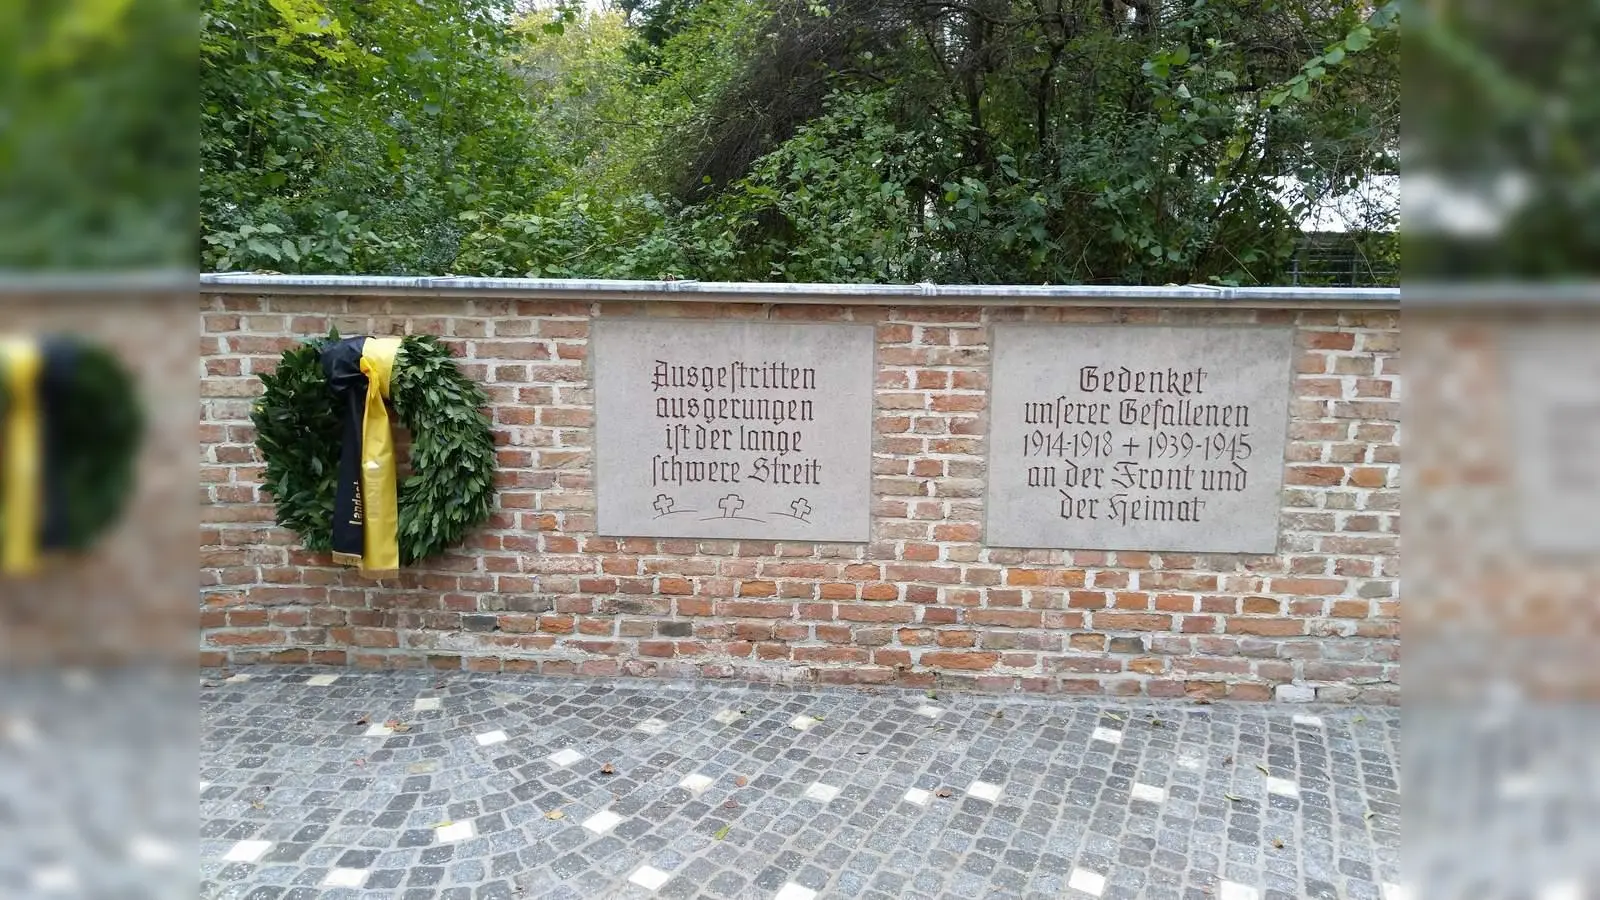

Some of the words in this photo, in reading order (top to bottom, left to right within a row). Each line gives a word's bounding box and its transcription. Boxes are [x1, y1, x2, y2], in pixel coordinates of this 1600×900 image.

[1080, 366, 1208, 396] Gedenket
[656, 397, 814, 425] ausgerungen
[1119, 398, 1249, 430] Gefallenen
[696, 424, 732, 450] der
[740, 425, 802, 456] lange
[1024, 430, 1112, 458] 1914-1918
[1148, 432, 1252, 461] 1939-1945
[747, 456, 821, 485] Streit
[1028, 467, 1056, 488] an
[1065, 459, 1104, 489] der
[1111, 462, 1195, 490] Front
[1201, 462, 1247, 492] und
[1059, 489, 1099, 520] der
[1108, 494, 1206, 526] Heimat
